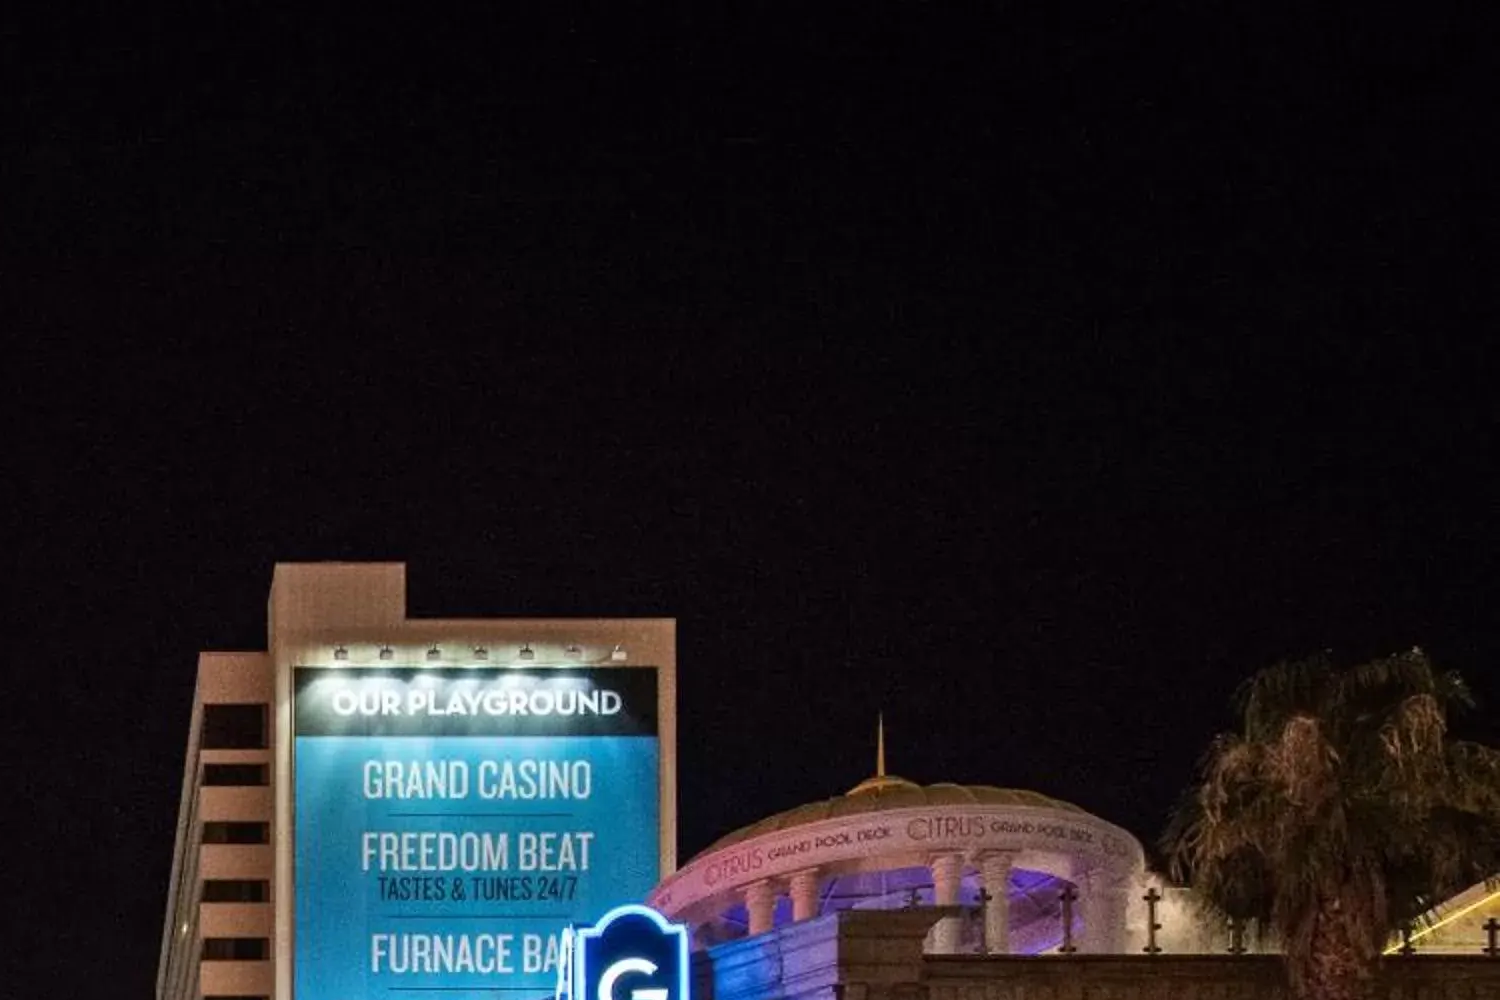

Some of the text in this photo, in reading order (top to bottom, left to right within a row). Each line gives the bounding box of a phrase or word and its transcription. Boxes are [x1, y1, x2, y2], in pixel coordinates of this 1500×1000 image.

[332, 690, 622, 717] OUR PLAYGROUND
[362, 760, 592, 800] GRAND CASINO
[905, 814, 986, 842] CITRUS
[361, 832, 595, 872] FREEDOM BEAT
[703, 847, 764, 888] CITRUS
[767, 840, 811, 861] GRAND
[378, 877, 578, 902] TASTES & TUNES 24/7
[371, 933, 562, 974] FURNACE BA
